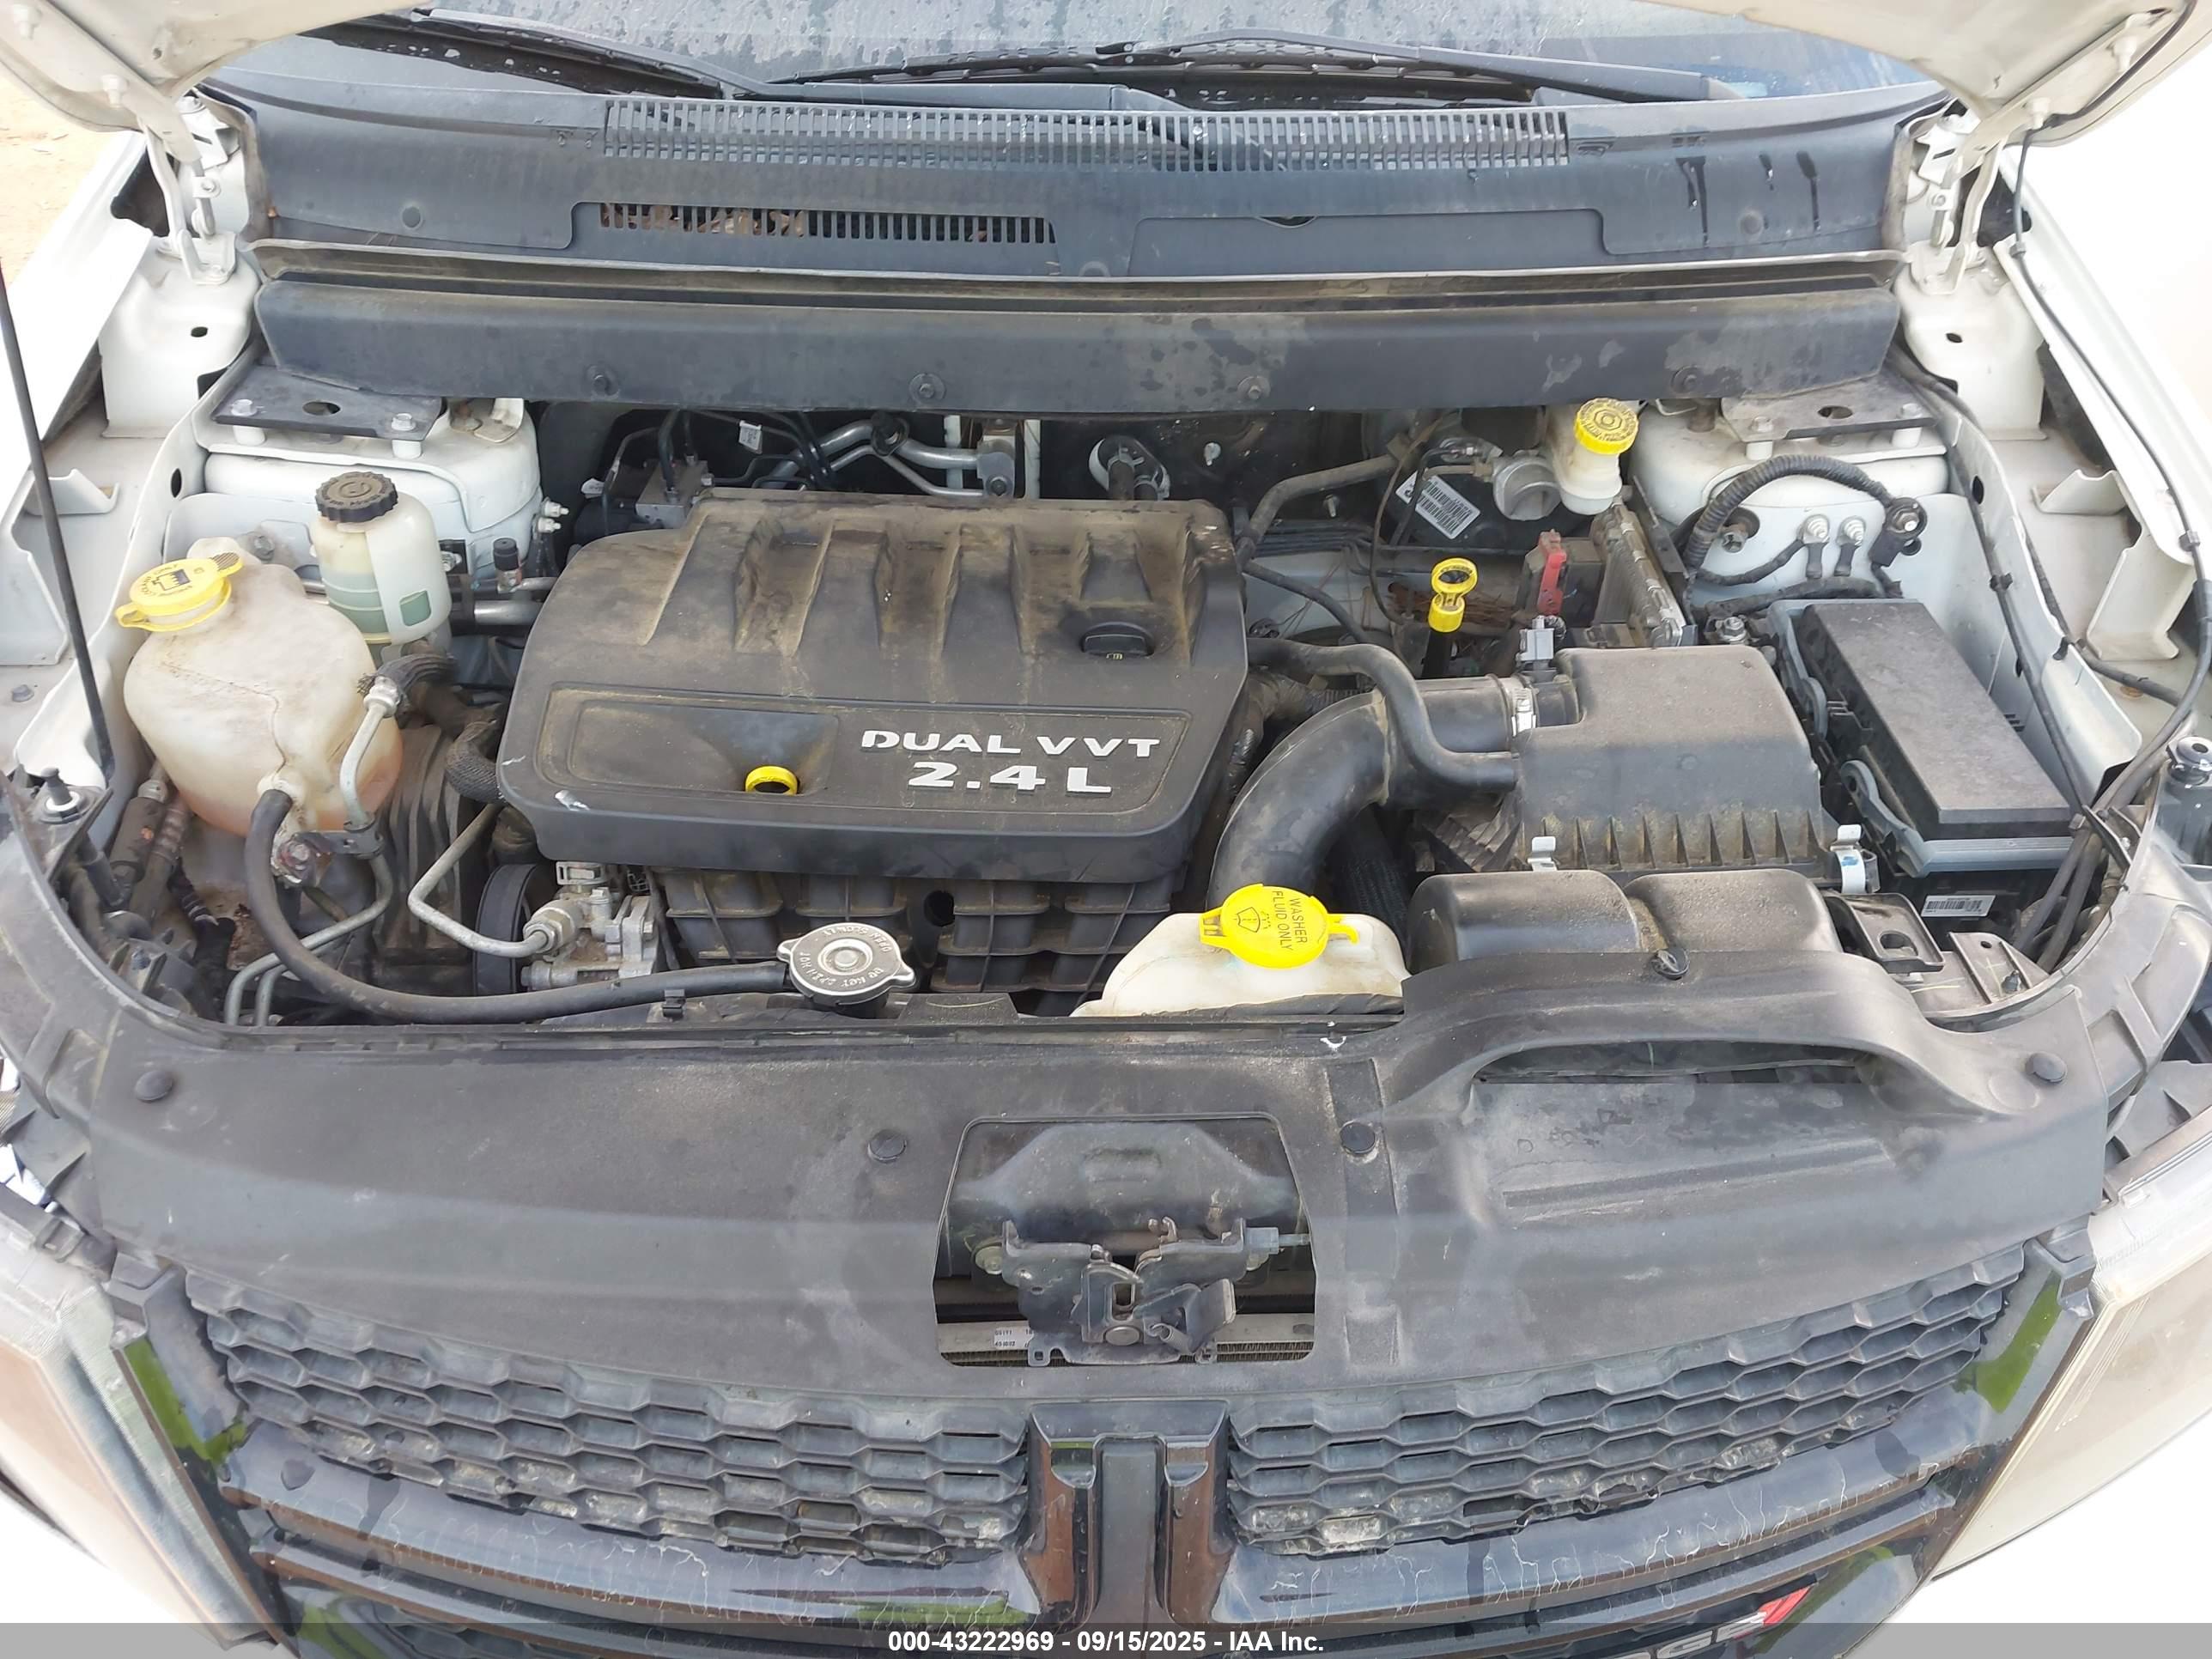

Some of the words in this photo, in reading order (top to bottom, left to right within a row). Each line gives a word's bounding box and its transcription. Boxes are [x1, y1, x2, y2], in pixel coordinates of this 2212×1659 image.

[860, 730, 1023, 754] DUAL
[1036, 735, 1161, 757] VVT
[1272, 890, 1288, 920] FLUID
[1289, 897, 1308, 944] WASHER
[869, 932, 894, 953] OPEN
[1277, 923, 1294, 951] ONLY
